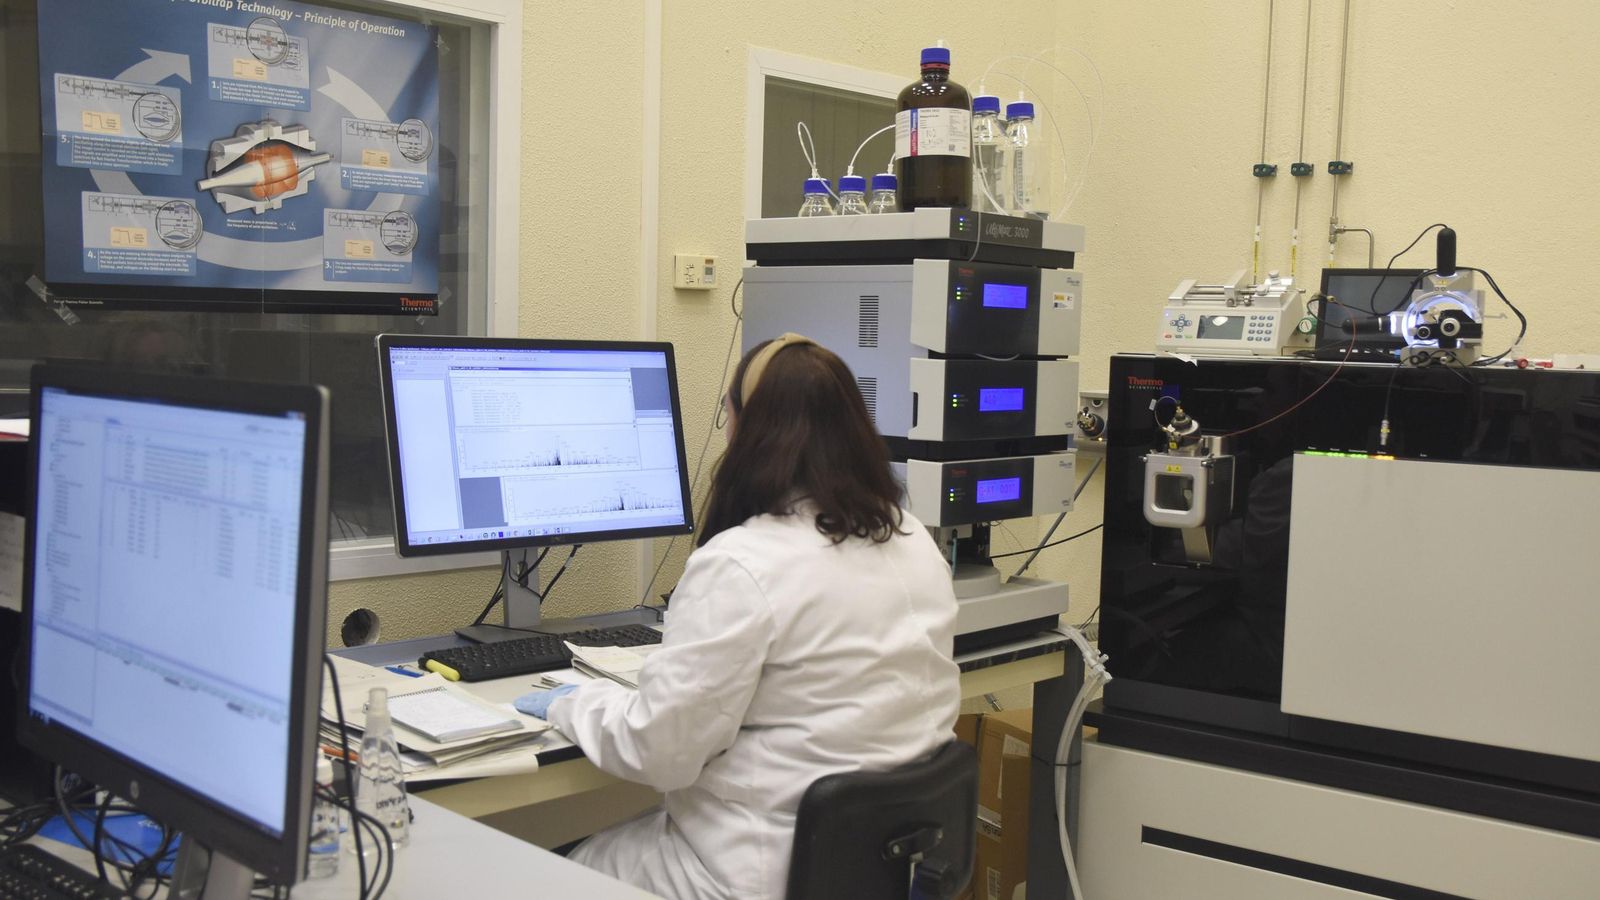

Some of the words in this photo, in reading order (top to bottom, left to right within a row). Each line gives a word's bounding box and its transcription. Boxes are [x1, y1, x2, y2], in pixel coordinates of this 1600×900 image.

[189, 0, 233, 11] rbitrap
[237, 1, 293, 21] Technology
[304, 11, 346, 28] Principle
[348, 19, 360, 32] of
[361, 21, 406, 37] Operation
[61, 134, 70, 143] 5.
[342, 170, 349, 178] 2.
[87, 250, 96, 259] 4.
[325, 260, 332, 269] 3.
[400, 297, 433, 307] Thermo
[1128, 376, 1164, 386] Thermo
